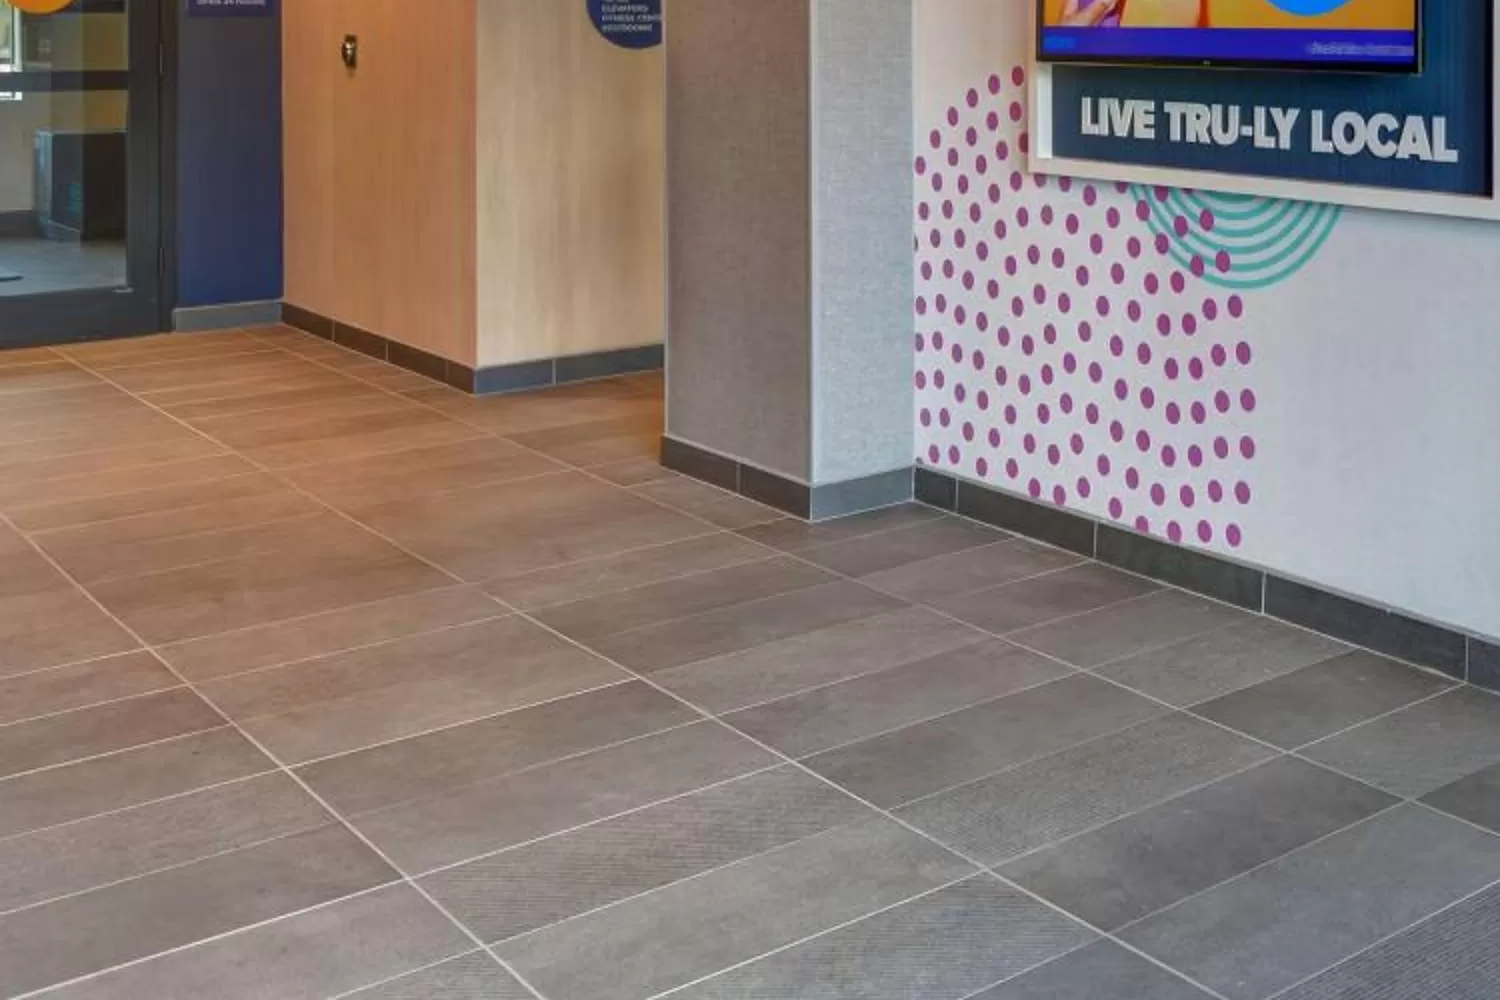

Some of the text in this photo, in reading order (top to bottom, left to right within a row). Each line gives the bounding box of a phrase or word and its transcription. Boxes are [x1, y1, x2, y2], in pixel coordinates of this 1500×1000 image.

[1080, 96, 1459, 163] LIVE TRU-LY LOCAL
